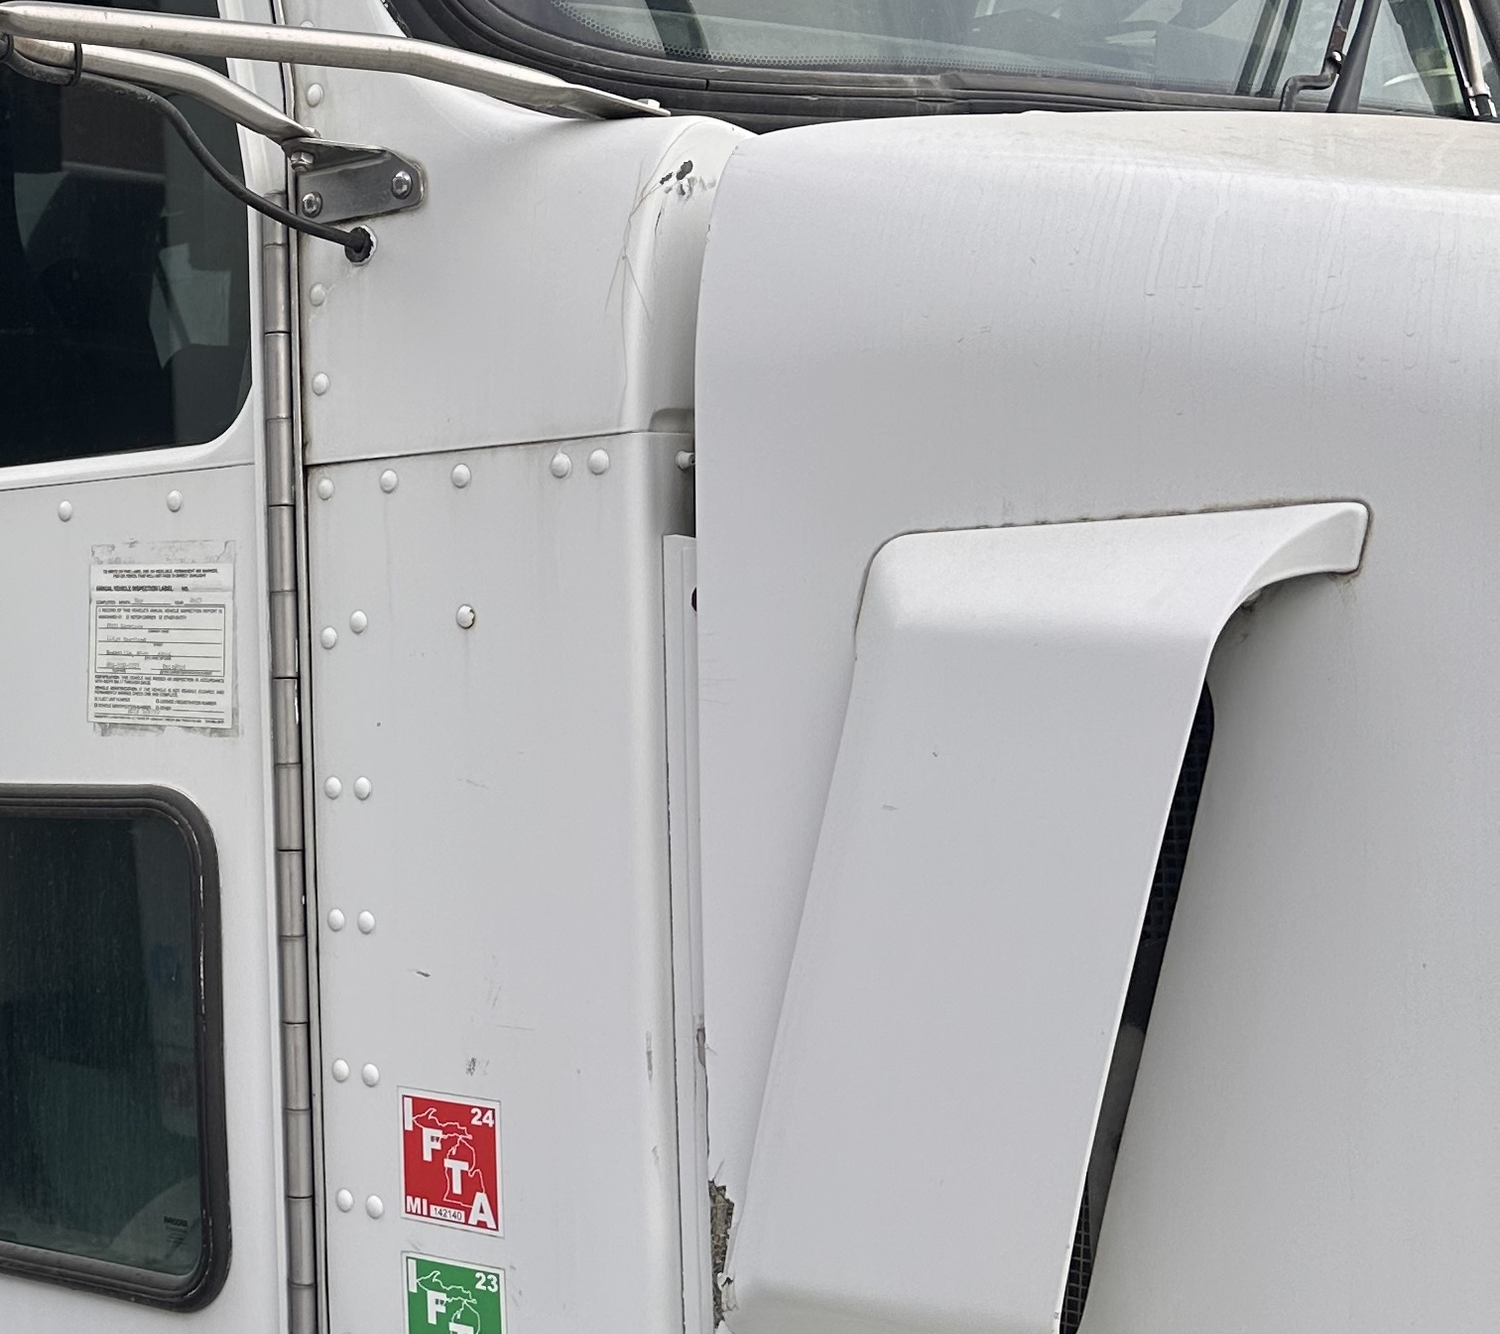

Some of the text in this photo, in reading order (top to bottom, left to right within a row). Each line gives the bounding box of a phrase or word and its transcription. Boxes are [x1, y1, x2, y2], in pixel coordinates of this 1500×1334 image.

[470, 1107, 495, 1127] 24
[406, 1195, 463, 1221] MI 142140
[475, 1272, 499, 1293] 23
